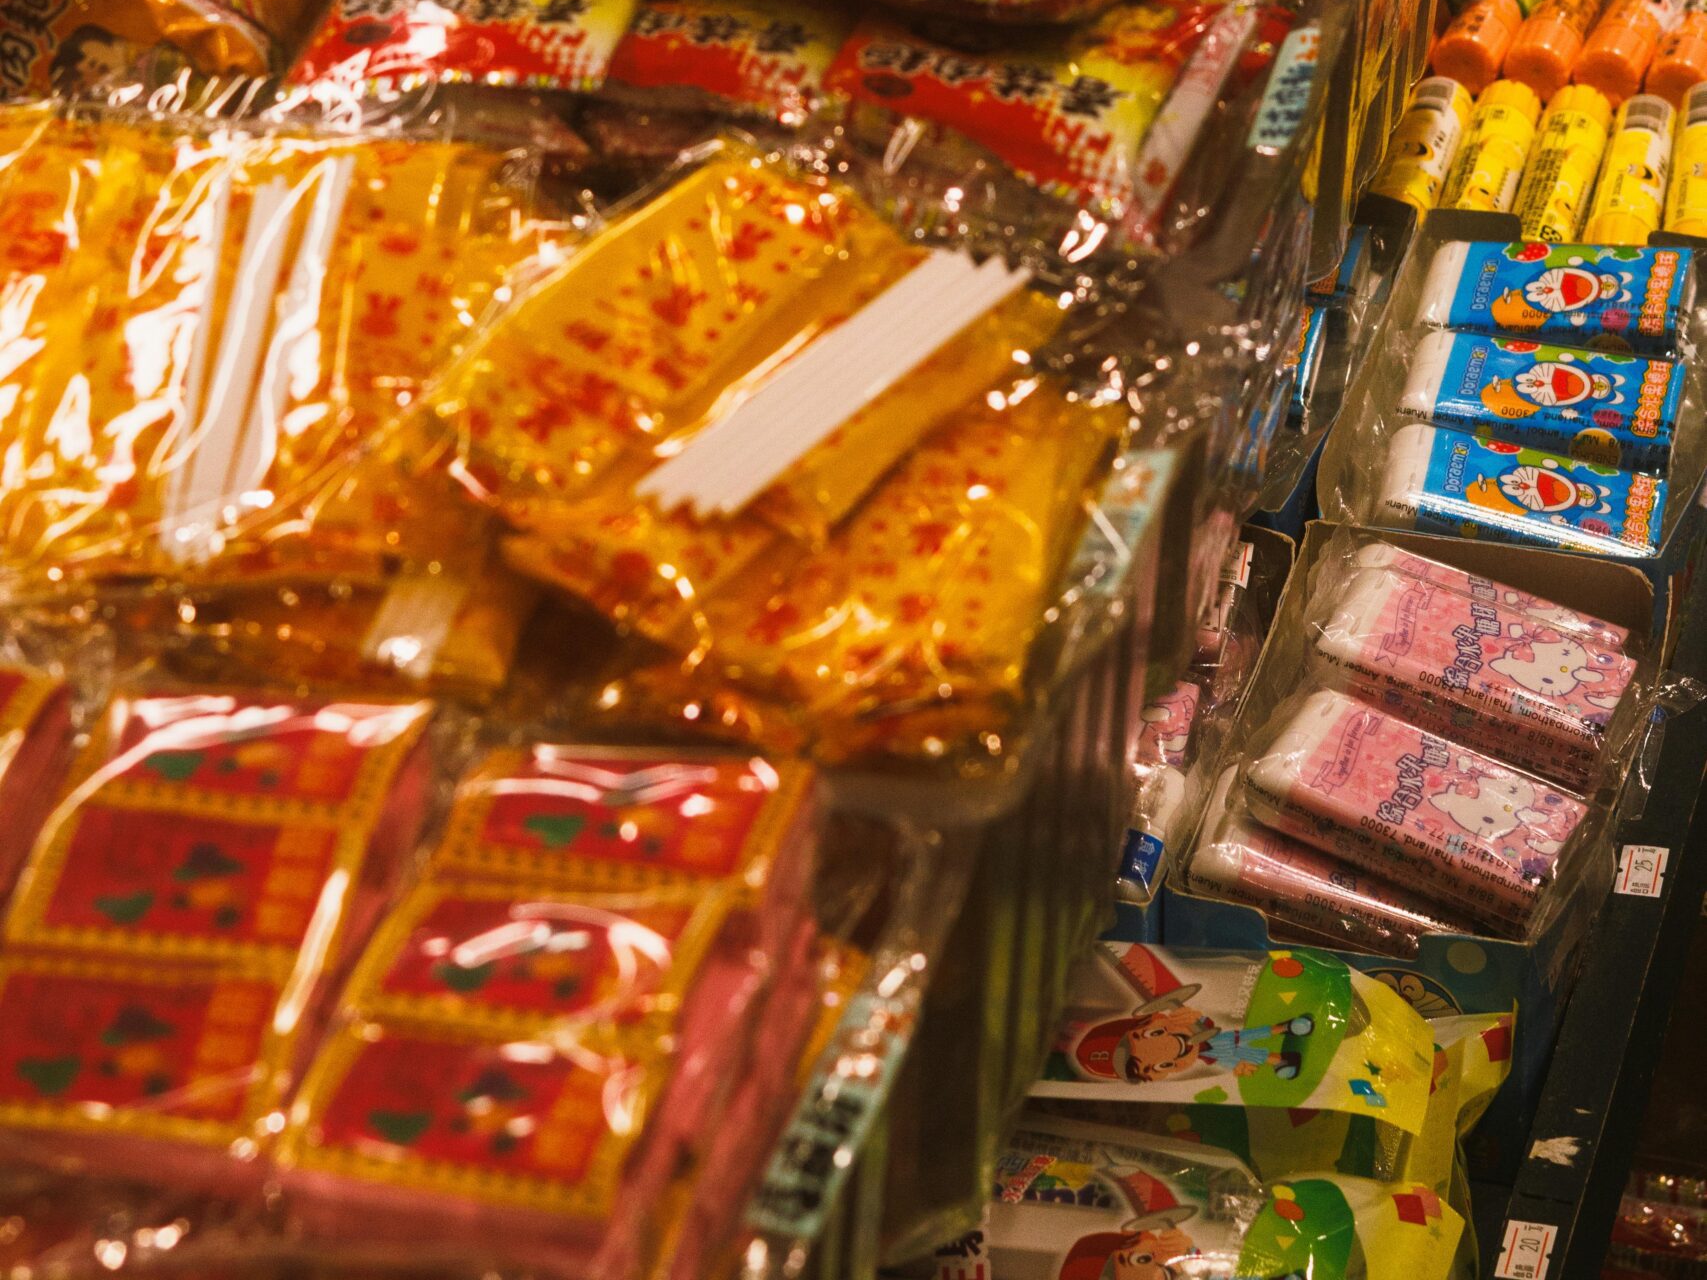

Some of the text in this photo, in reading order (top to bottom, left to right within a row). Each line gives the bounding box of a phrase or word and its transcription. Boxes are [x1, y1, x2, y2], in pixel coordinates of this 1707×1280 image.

[1470, 258, 1498, 311] Doraemon
[1459, 346, 1488, 396] Doraemon
[1444, 441, 1469, 493] Doraemon
[1358, 813, 1399, 840] 73000
[1633, 858, 1654, 874] 25
[1519, 1238, 1541, 1253] 20
